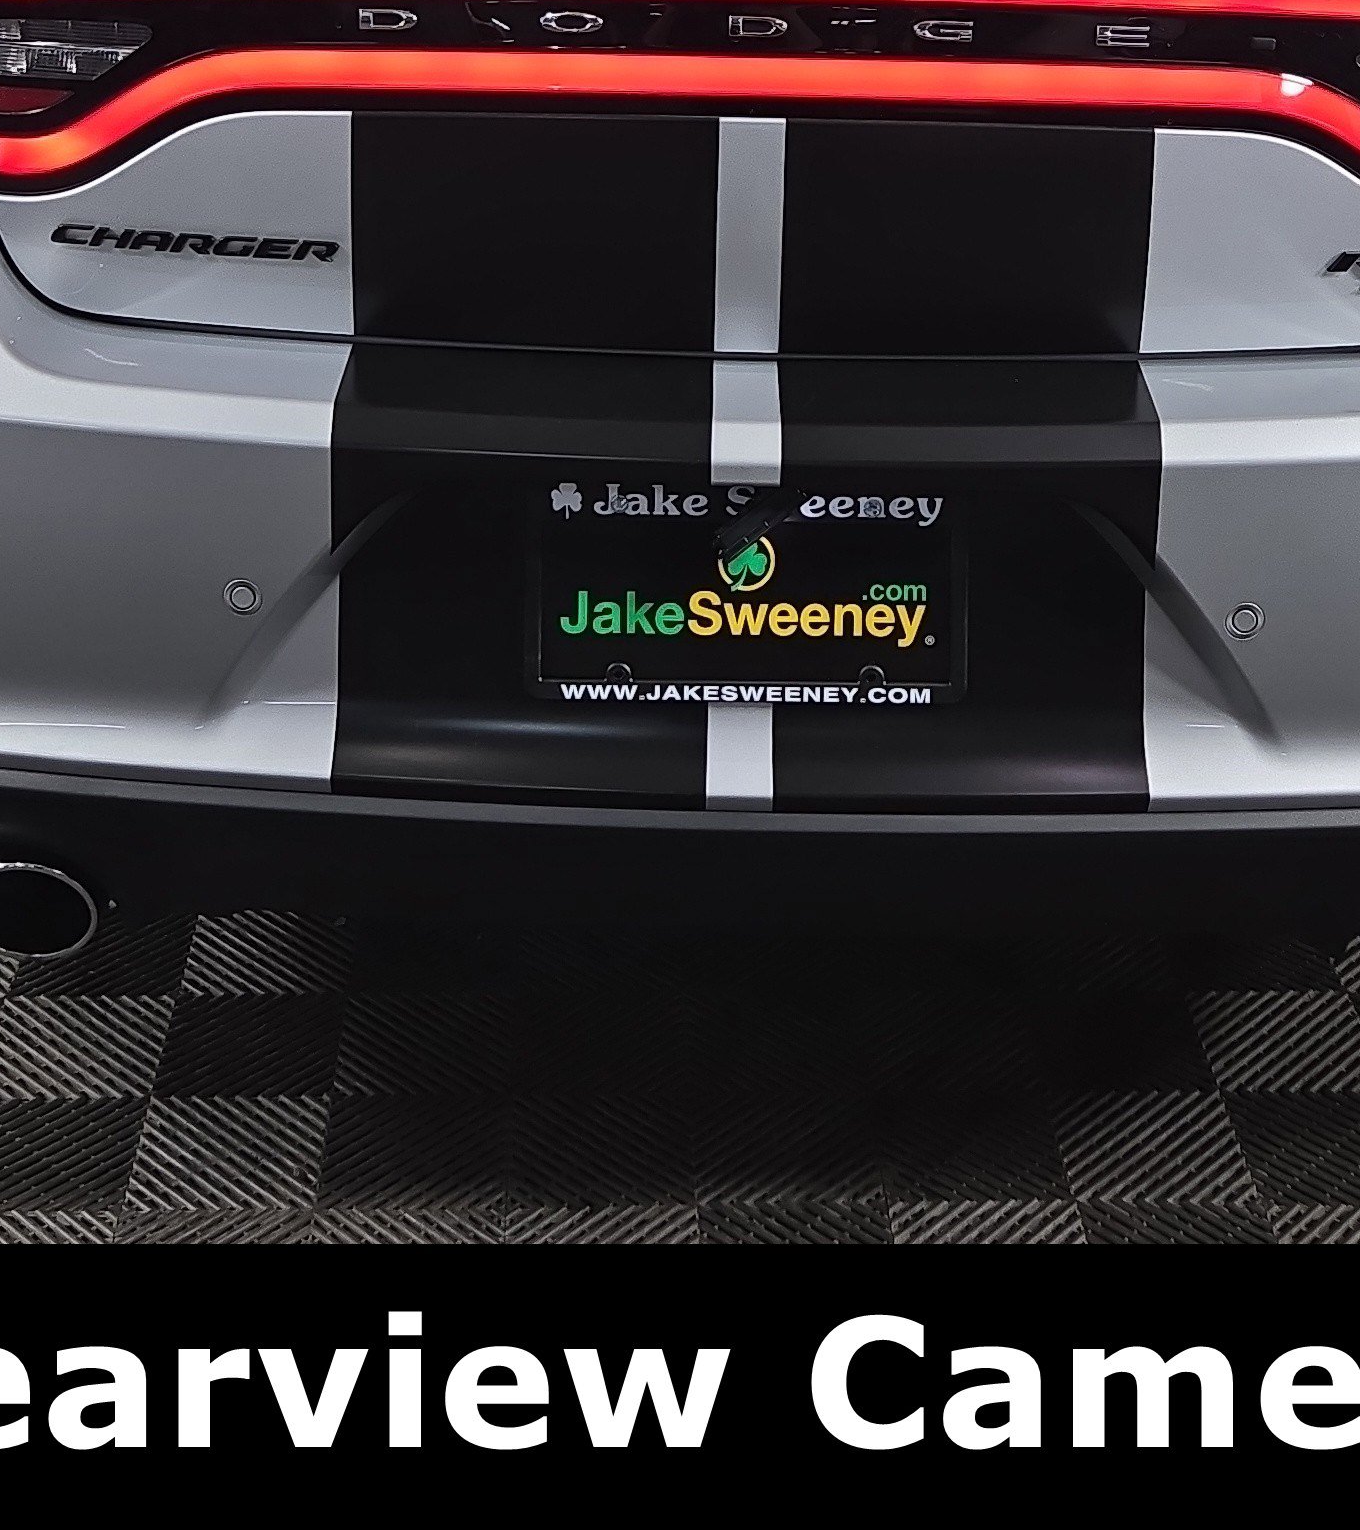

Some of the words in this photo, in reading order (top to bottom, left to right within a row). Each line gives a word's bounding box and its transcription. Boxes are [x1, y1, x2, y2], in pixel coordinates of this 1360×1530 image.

[357, 6, 1151, 49] DODGE
[50, 223, 341, 263] CHARGER
[593, 483, 709, 516] Jake
[726, 485, 944, 527] Seeney
[559, 590, 926, 647] JakeSweeney
[560, 683, 932, 704] WWW.JAKESWEENEY.COM
